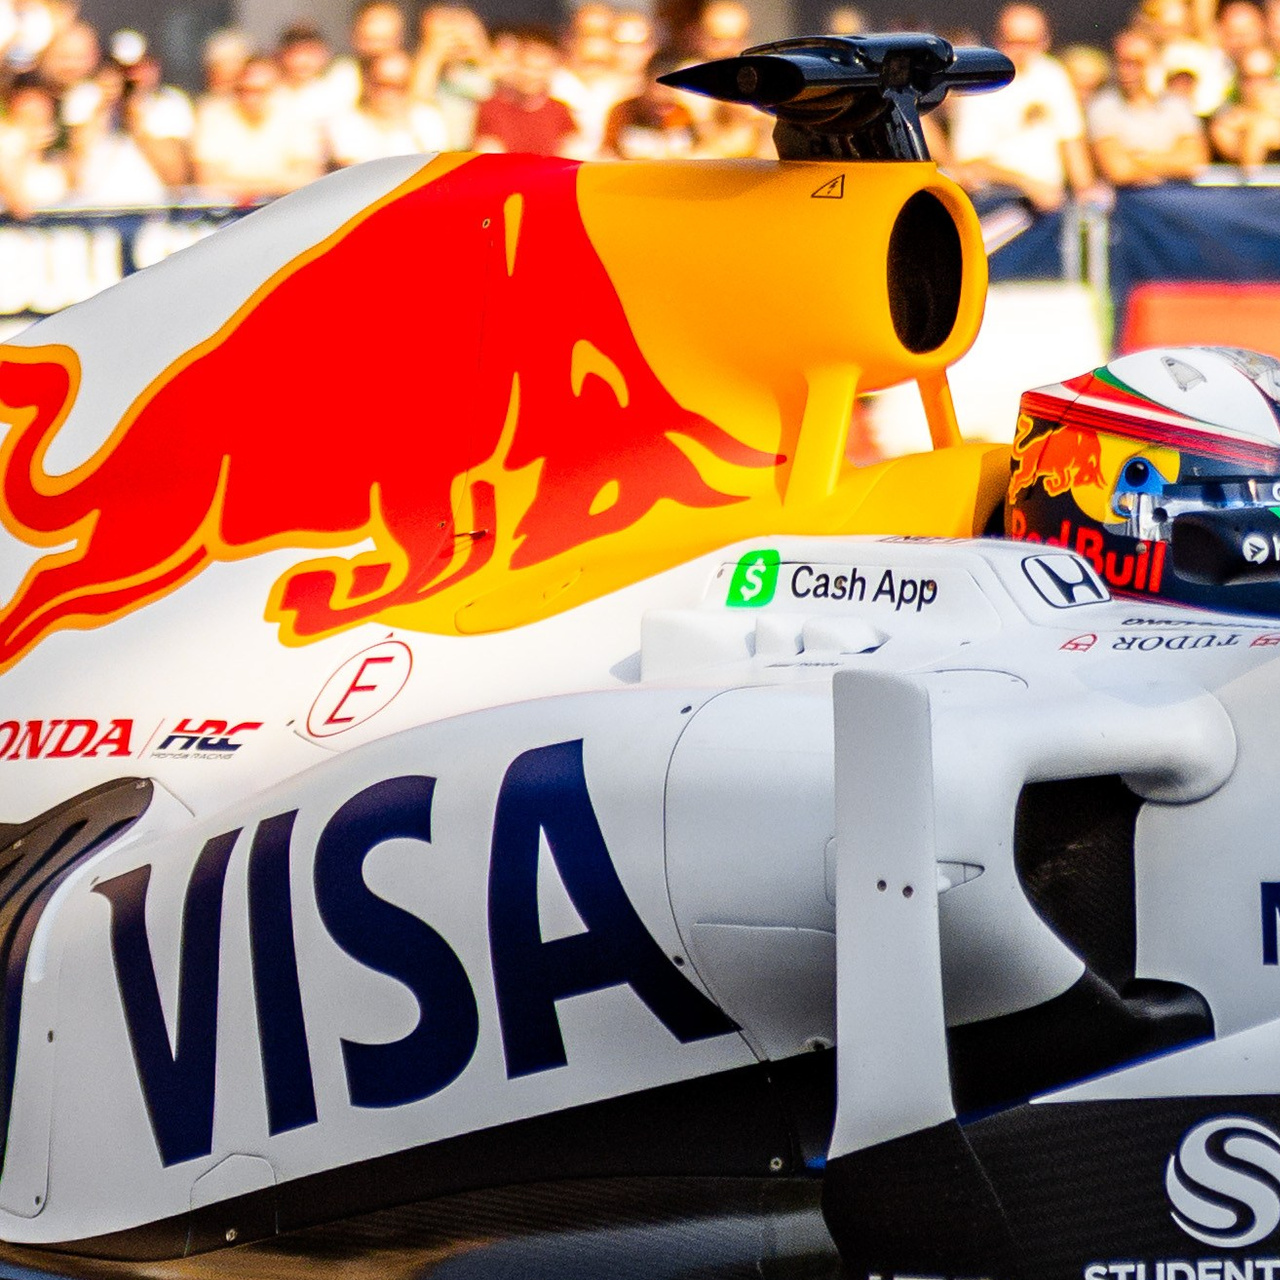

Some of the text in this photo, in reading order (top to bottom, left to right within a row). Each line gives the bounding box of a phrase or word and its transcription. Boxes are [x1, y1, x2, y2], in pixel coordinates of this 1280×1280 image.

[791, 565, 939, 612] Cash App
[1075, 526, 1167, 593] Bull
[1112, 633, 1242, 651] TUDOR
[323, 656, 395, 726] E
[91, 738, 744, 1169] VISA
